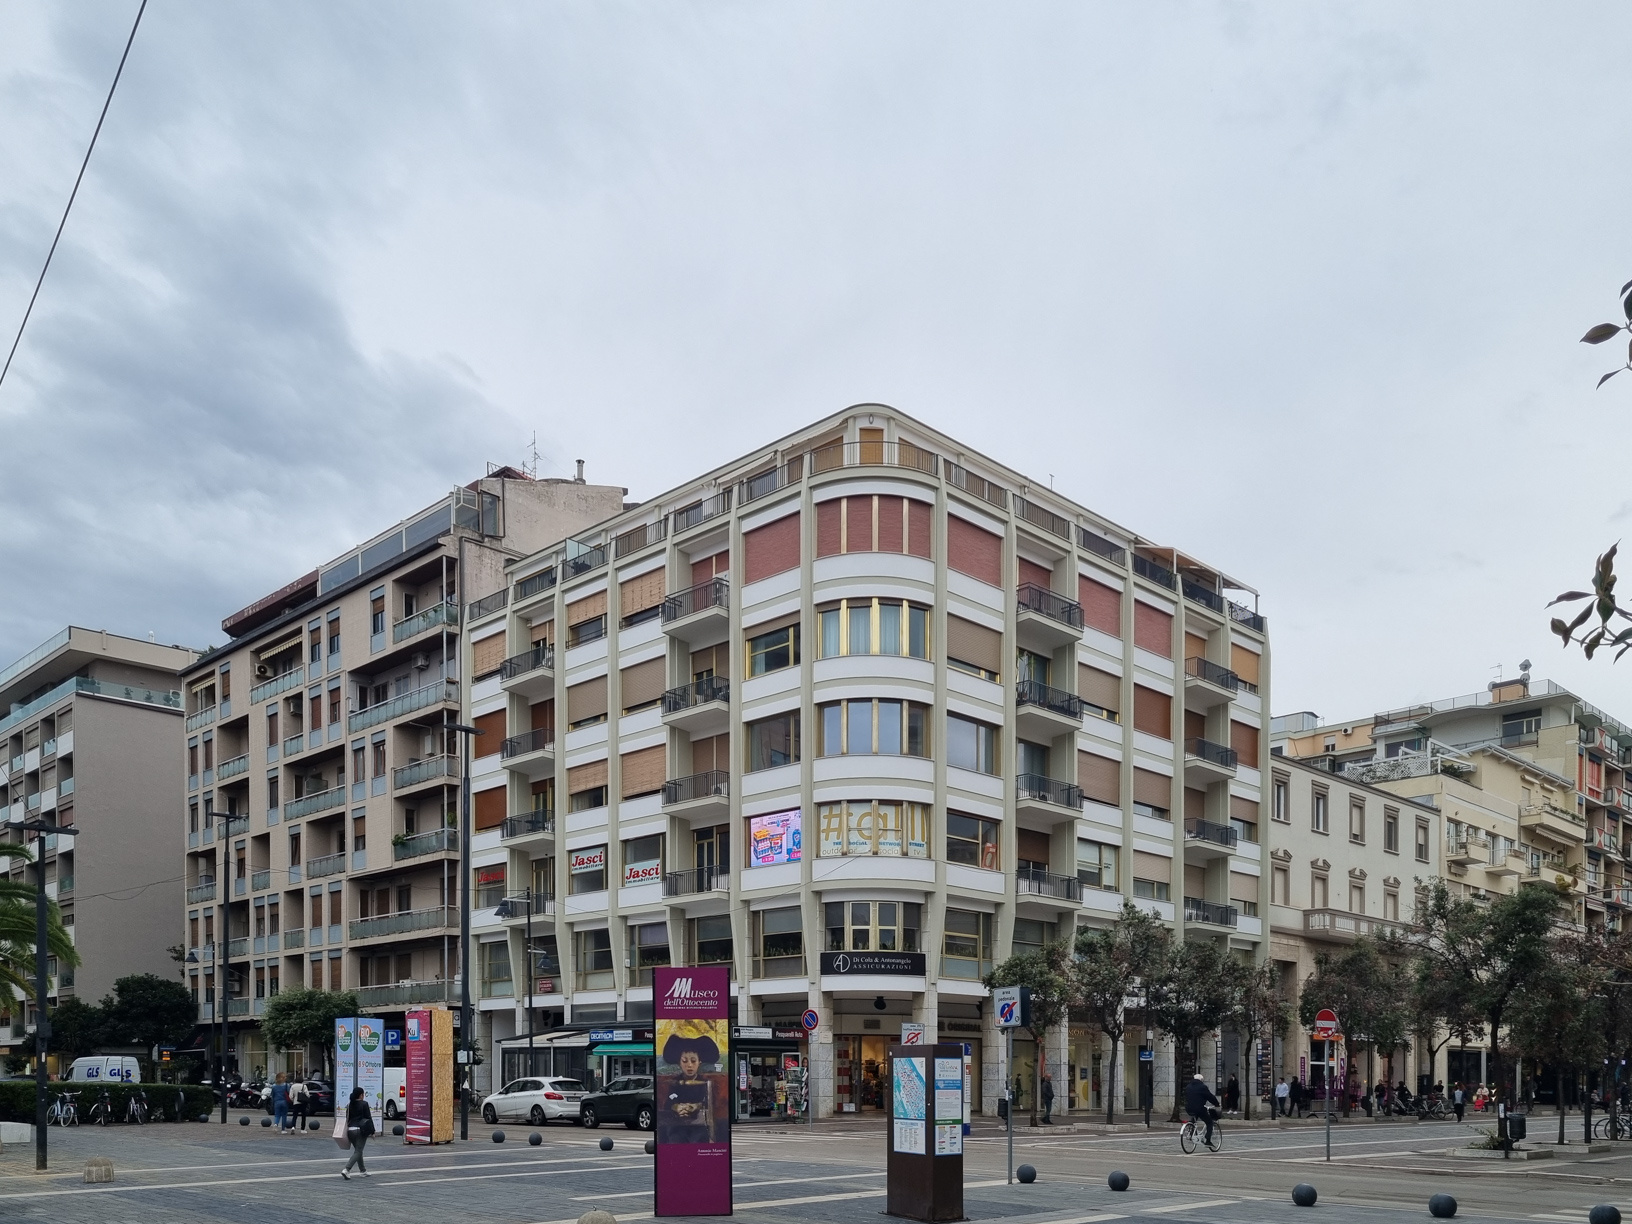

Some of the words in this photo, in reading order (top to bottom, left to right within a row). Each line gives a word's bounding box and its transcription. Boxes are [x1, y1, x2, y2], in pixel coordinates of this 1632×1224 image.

[572, 851, 603, 867] Jasci
[572, 863, 604, 871] immobiliare
[625, 864, 661, 880] Jasci
[478, 868, 505, 883] Jasci
[625, 876, 660, 884] immobiliare
[664, 977, 718, 998] Museo
[663, 997, 718, 1006] dell'Ottocento
[388, 1032, 397, 1043] P
[87, 1067, 99, 1078] GLS
